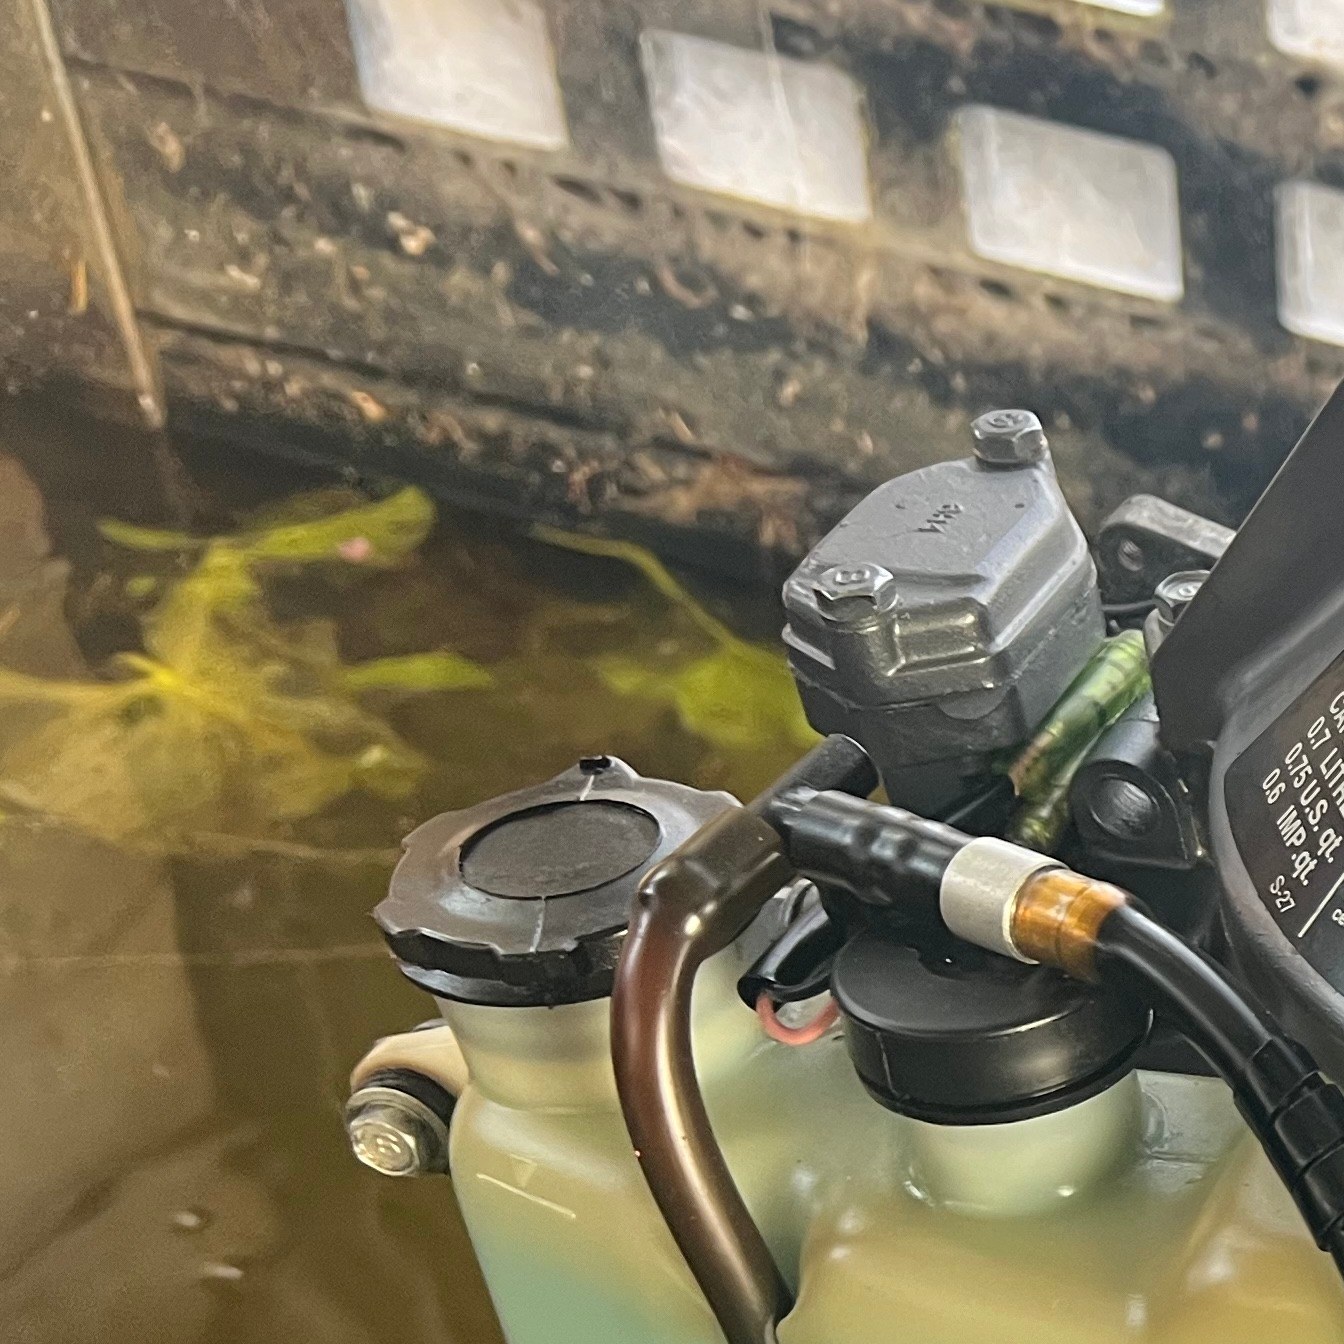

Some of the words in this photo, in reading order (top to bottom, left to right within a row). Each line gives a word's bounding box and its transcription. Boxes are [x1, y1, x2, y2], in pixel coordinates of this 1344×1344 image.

[1307, 716, 1331, 750] 0.7
[1263, 768, 1286, 804] 0.6
[1285, 742, 1312, 788] 0.75
[1300, 779, 1328, 832] U.S.
[1317, 828, 1343, 863] qt.
